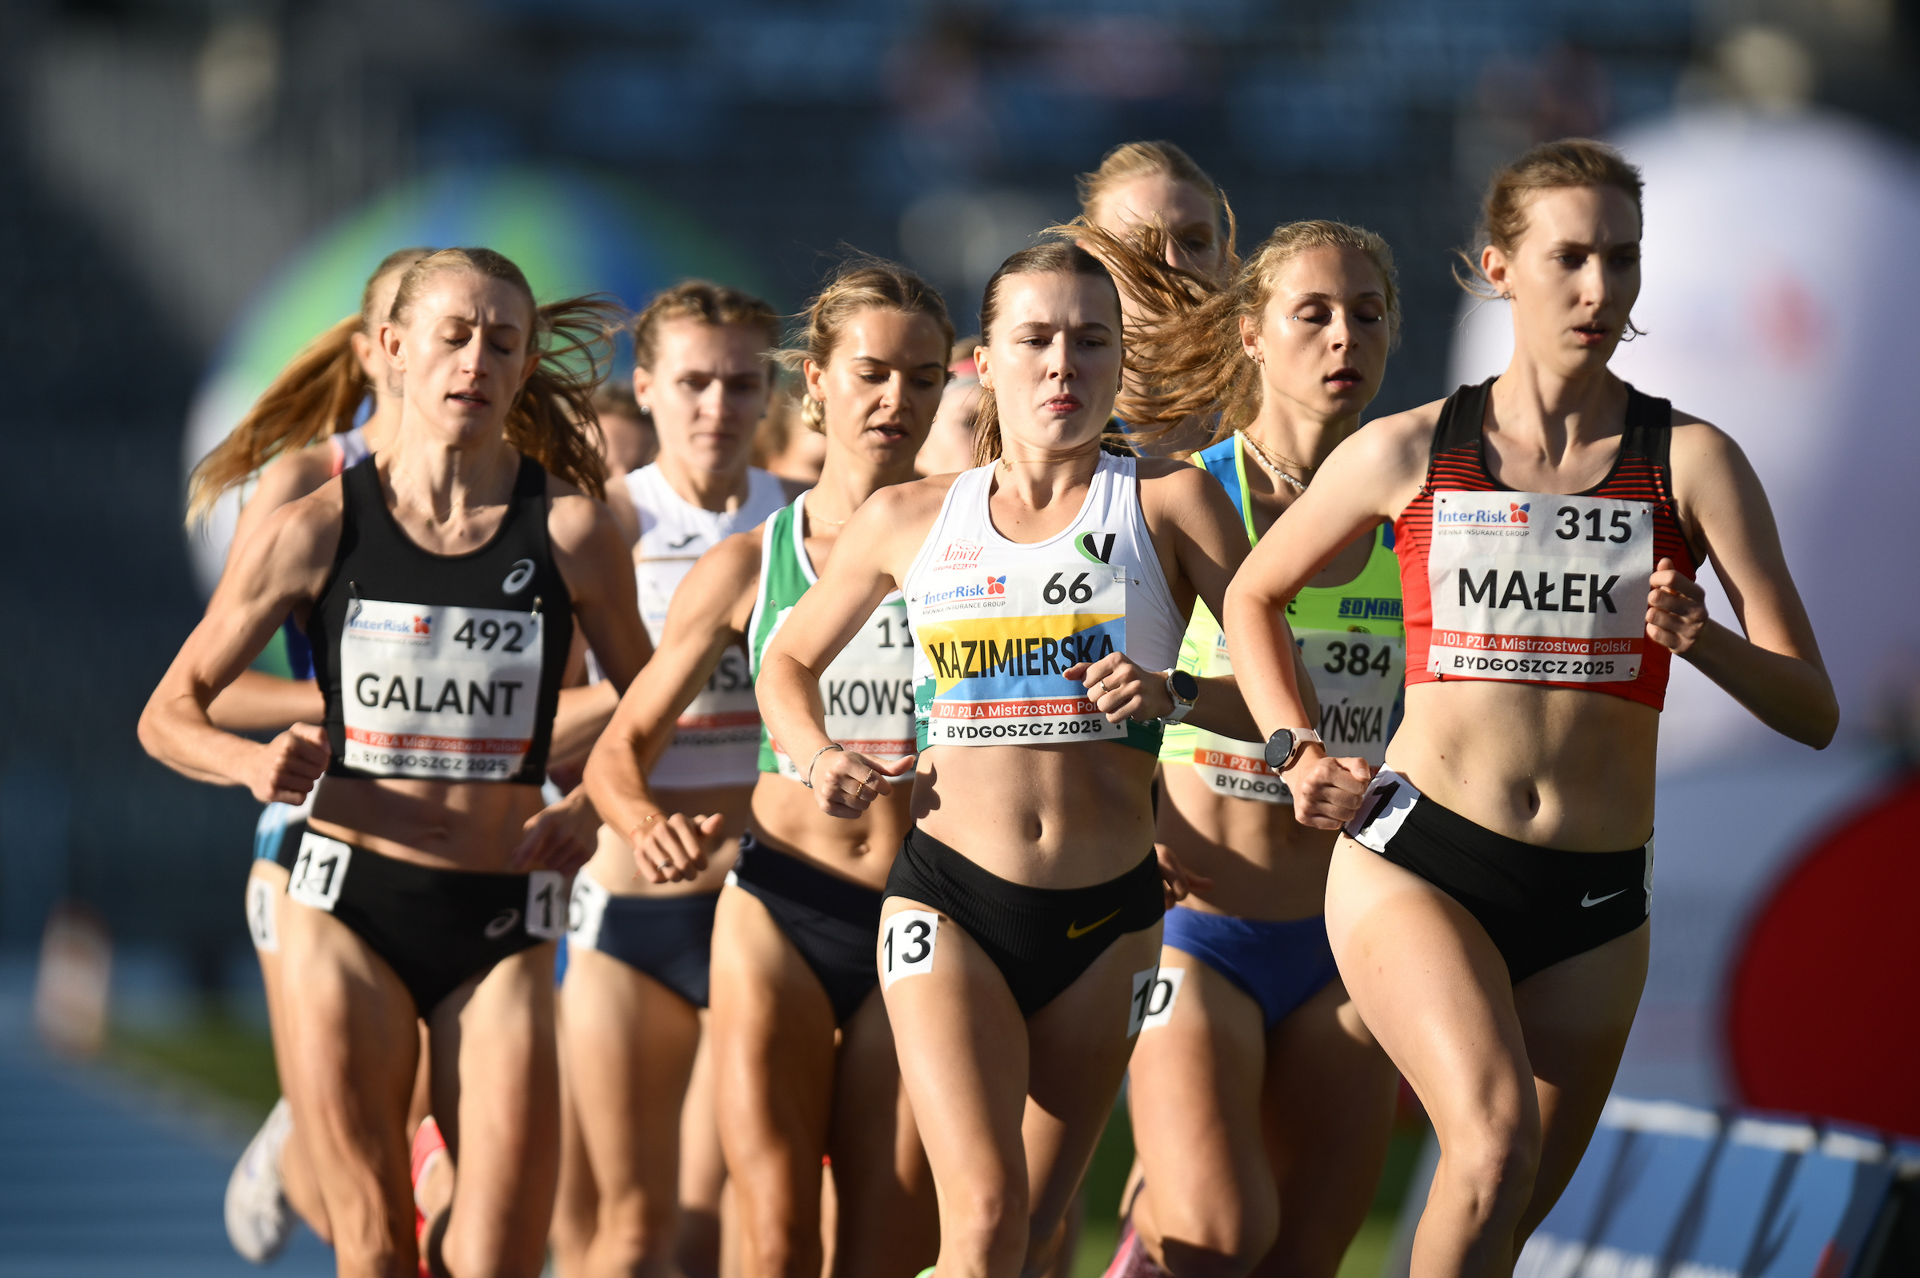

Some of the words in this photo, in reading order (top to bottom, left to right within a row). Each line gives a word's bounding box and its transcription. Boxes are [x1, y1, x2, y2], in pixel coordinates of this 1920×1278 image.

[1438, 509, 1507, 523] InterRisk
[1555, 505, 1632, 544] 315
[1464, 529, 1503, 537] INSURANCE
[925, 585, 984, 605] InterRisk
[1043, 572, 1093, 605] 66
[1459, 568, 1620, 614] MAŁEK
[945, 602, 981, 611] INSURANCE
[349, 615, 411, 633] InterRisk
[454, 618, 524, 652] 492
[1442, 632, 1464, 646] 101.
[1466, 635, 1497, 649] PZLA
[1501, 637, 1590, 653] Mistrzostwa
[1594, 640, 1631, 652] Polski
[1324, 641, 1391, 677] 384
[1454, 655, 1567, 674] BYDGOSZCZ
[1572, 661, 1615, 675] 2025
[356, 673, 523, 716] GALANT
[823, 680, 915, 716] KOWS
[939, 704, 955, 717] 101.
[958, 703, 984, 717] PZLA
[988, 702, 1073, 717] Mistrzostwa
[1077, 701, 1099, 713] Pol
[947, 722, 1054, 738] BYDGOSZCZ
[1059, 720, 1102, 735] 2025
[402, 735, 482, 751] Mistrzostwa
[363, 751, 462, 770] BYDGOSZCZ
[467, 757, 510, 772] 2025
[1205, 751, 1226, 766] 101.
[1230, 756, 1262, 771] PZLA
[298, 848, 338, 896] 11
[884, 920, 931, 973] 13
